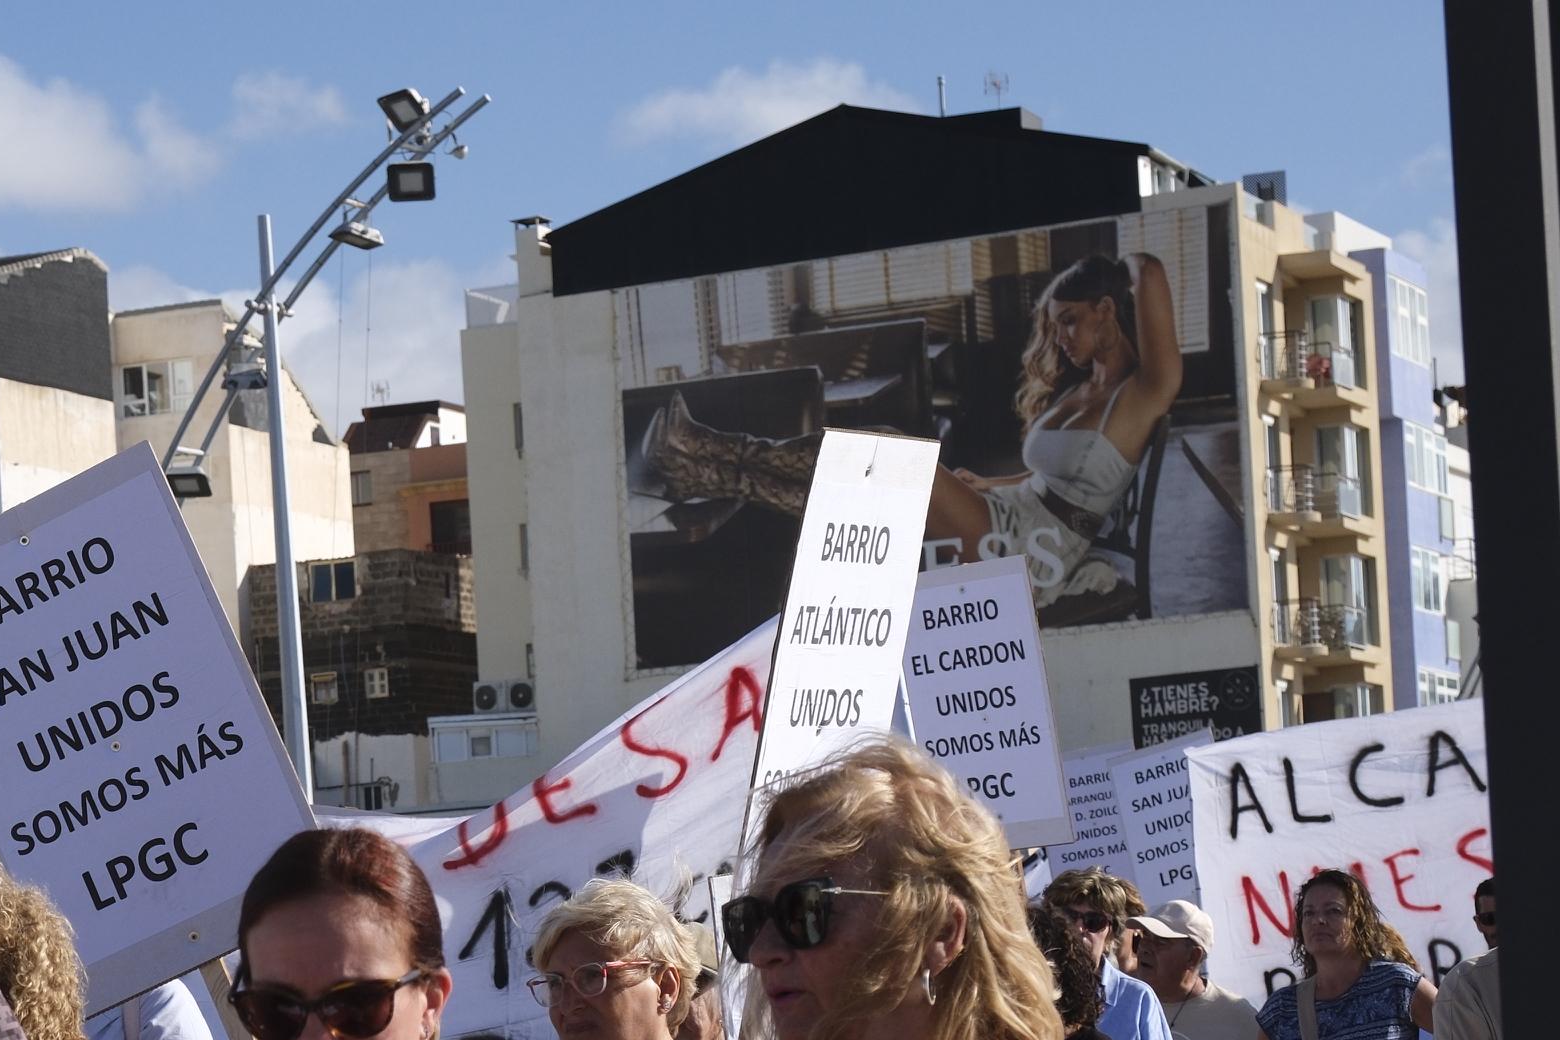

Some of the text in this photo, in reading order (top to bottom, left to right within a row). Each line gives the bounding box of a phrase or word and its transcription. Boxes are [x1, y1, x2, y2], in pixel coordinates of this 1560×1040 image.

[821, 523, 890, 565] BARRIO
[922, 527, 1065, 588] ESS
[790, 596, 891, 647] ATLÁNTICO
[923, 599, 999, 631] BARRIO
[65, 591, 170, 674] JUAN
[911, 639, 1026, 676] EL CARDON
[790, 689, 863, 728] UNIDOS
[936, 685, 1017, 718] UNIDOS
[1140, 681, 1209, 703] ¿TIENES
[1141, 695, 1220, 718] HAMBRE?
[16, 671, 180, 773] UNIDOS
[925, 722, 1041, 758] SOMOS MÁS
[10, 720, 244, 856] SOMOS MÁS
[966, 772, 1016, 800] PGC
[1229, 730, 1487, 840] ALCA
[1075, 812, 1087, 822] D.
[1131, 792, 1162, 813] SAN
[1144, 810, 1191, 835] UNIDO
[82, 822, 209, 912] LPGC
[1061, 846, 1105, 863] SOMOS
[1107, 840, 1127, 855] MÁ
[1136, 838, 1189, 864] SOMOS
[1159, 864, 1193, 887] LPG
